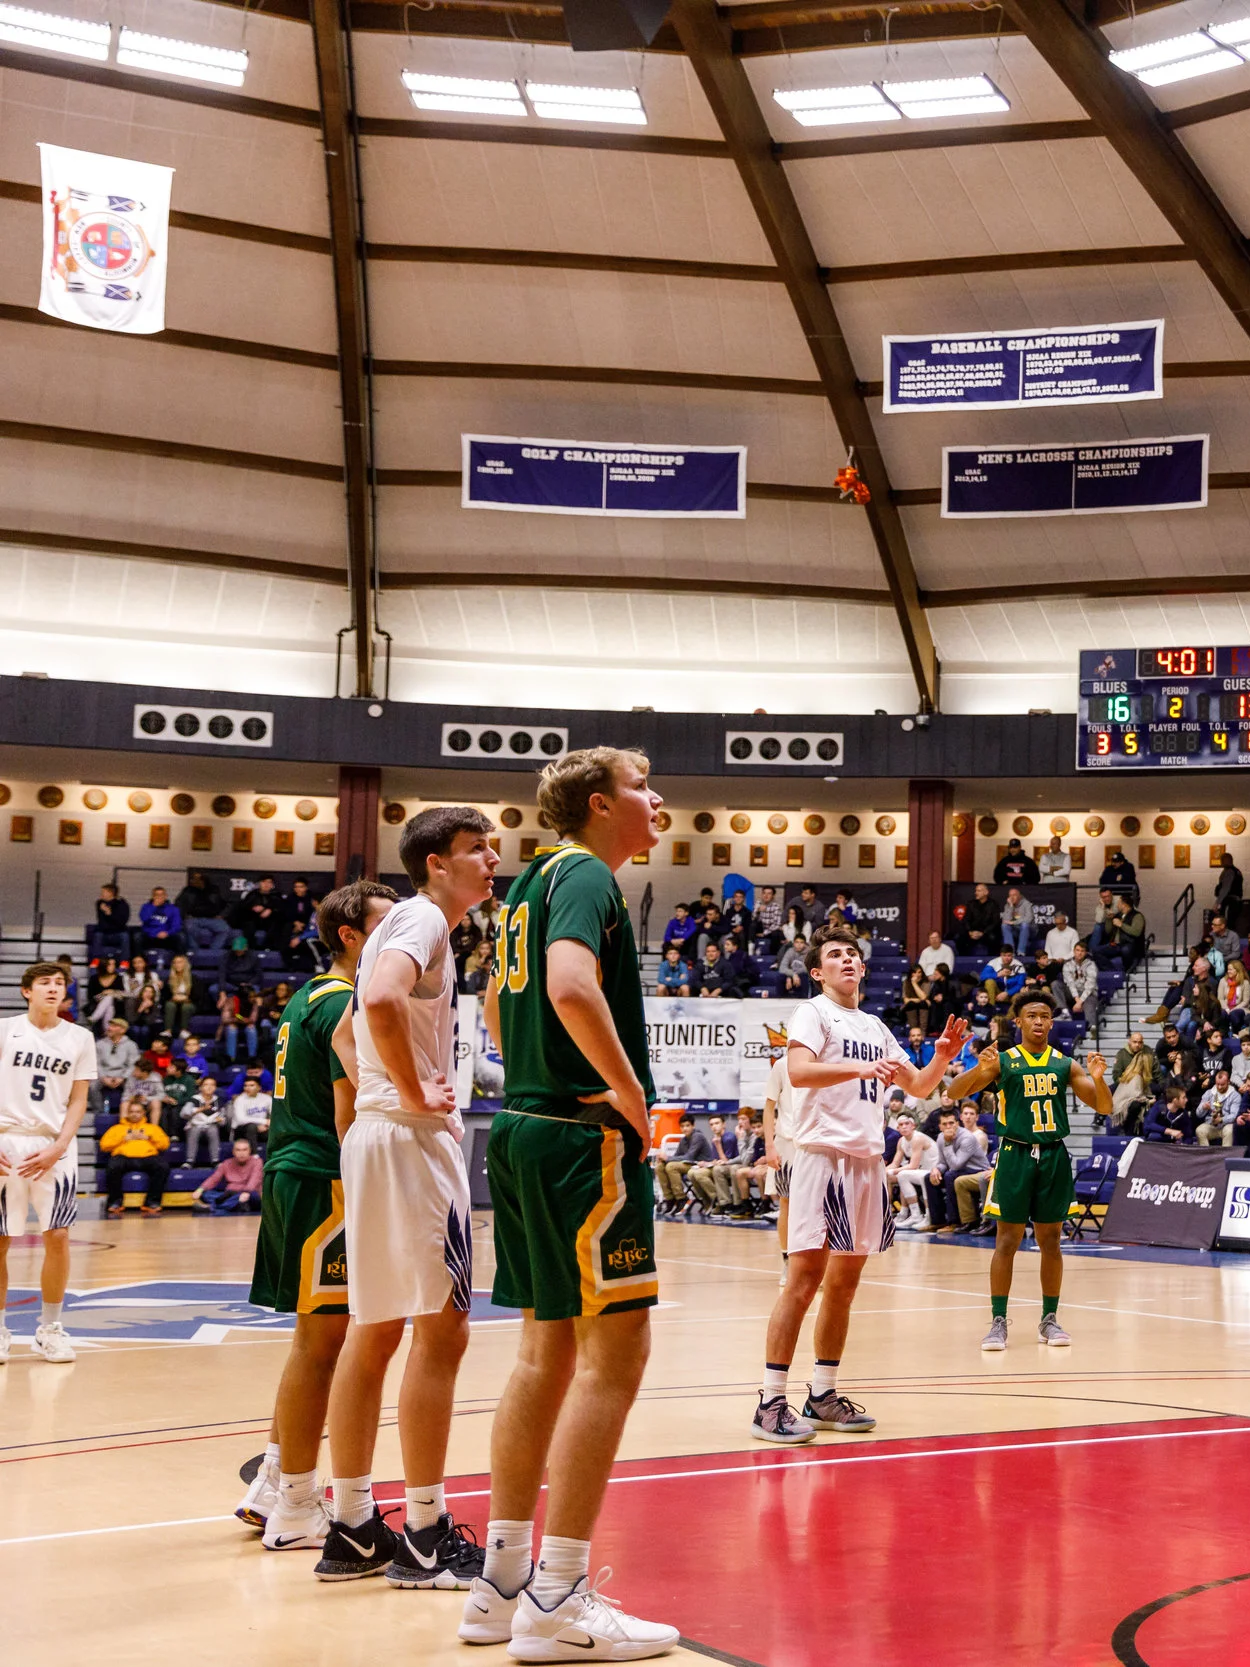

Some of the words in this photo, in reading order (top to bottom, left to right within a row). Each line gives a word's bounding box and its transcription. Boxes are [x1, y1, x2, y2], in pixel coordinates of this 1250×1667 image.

[931, 340, 1003, 354] BASEBALL
[1006, 333, 1121, 351] CHAMPIONSHIPS
[521, 447, 560, 461] GOLF
[563, 450, 685, 465] CHAMPIONSHIPS
[978, 453, 1013, 465] MEN'S
[1016, 451, 1075, 464] LACROSSE
[1078, 445, 1174, 461] CHAMPIONSHIPS
[1157, 648, 1213, 675] 4:01
[1092, 681, 1128, 694] BLUES
[1161, 686, 1190, 696] PERIOD
[1107, 695, 1131, 722] 16
[1169, 697, 1184, 719] 2
[1087, 724, 1112, 733] FOULS
[1120, 723, 1141, 733] T.O.L.
[1148, 723, 1178, 733] PLAYER
[1181, 722, 1201, 732] FOUL
[1209, 722, 1230, 731] T.O.L.
[1097, 733, 1111, 755] 3
[1124, 733, 1138, 754] 5
[1213, 732, 1227, 751] 4
[1086, 757, 1112, 767] SCORE
[1160, 756, 1188, 765] MATCH
[856, 906, 899, 922] roup
[495, 902, 529, 994] 33
[646, 1024, 736, 1046] RTUNITIES
[745, 1042, 786, 1059] Hoo
[13, 1051, 72, 1075] EAGLES
[30, 1074, 46, 1102] 5
[1023, 1073, 1058, 1098] RBC
[1030, 1100, 1057, 1133] 11
[1127, 1177, 1169, 1206] Hoop
[1169, 1180, 1217, 1210] Group
